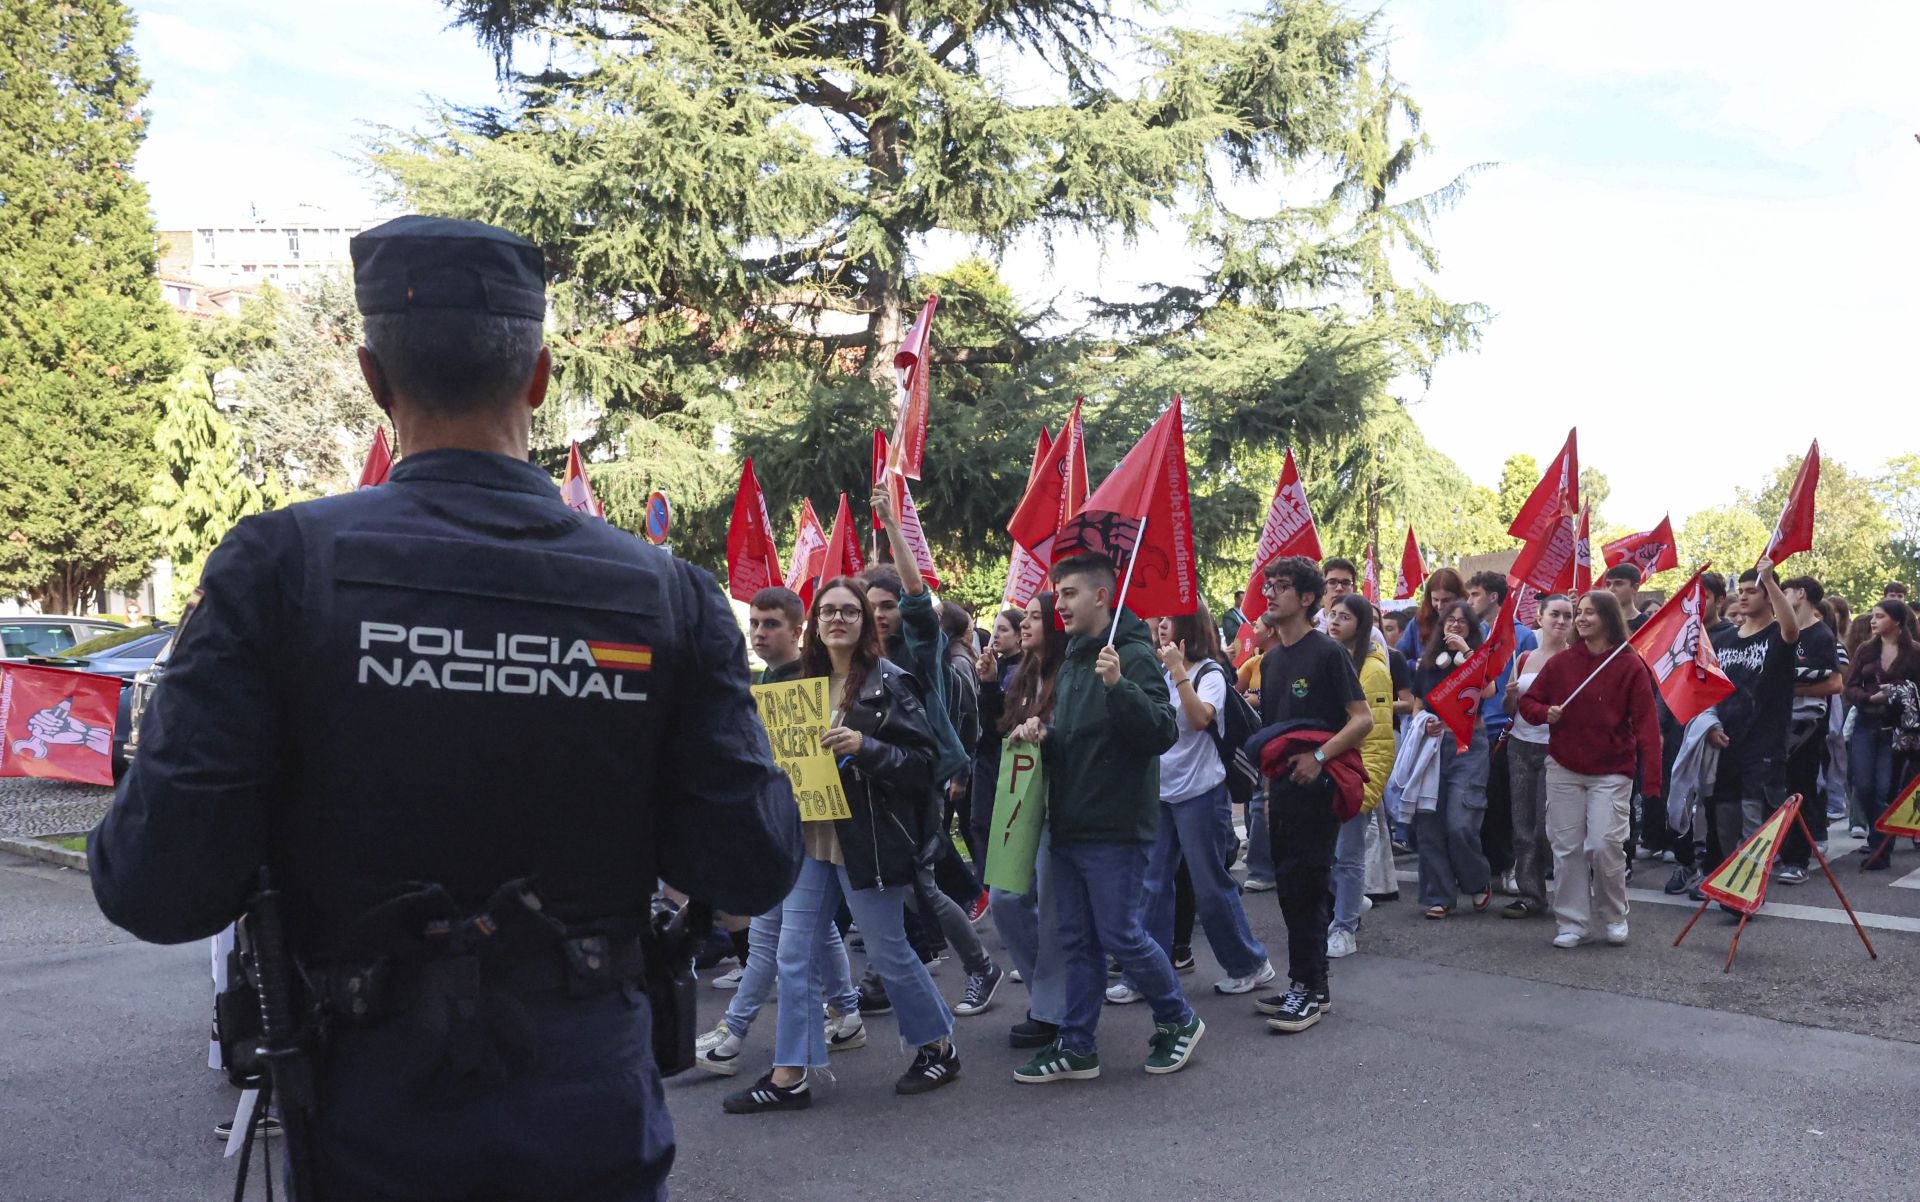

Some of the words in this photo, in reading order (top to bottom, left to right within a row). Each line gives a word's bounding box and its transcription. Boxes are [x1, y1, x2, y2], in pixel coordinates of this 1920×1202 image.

[1171, 511, 1191, 605] Estudiantes
[360, 621, 598, 667] POLICIA
[358, 655, 648, 701] NACIONAL
[1432, 665, 1474, 705] Sindicato
